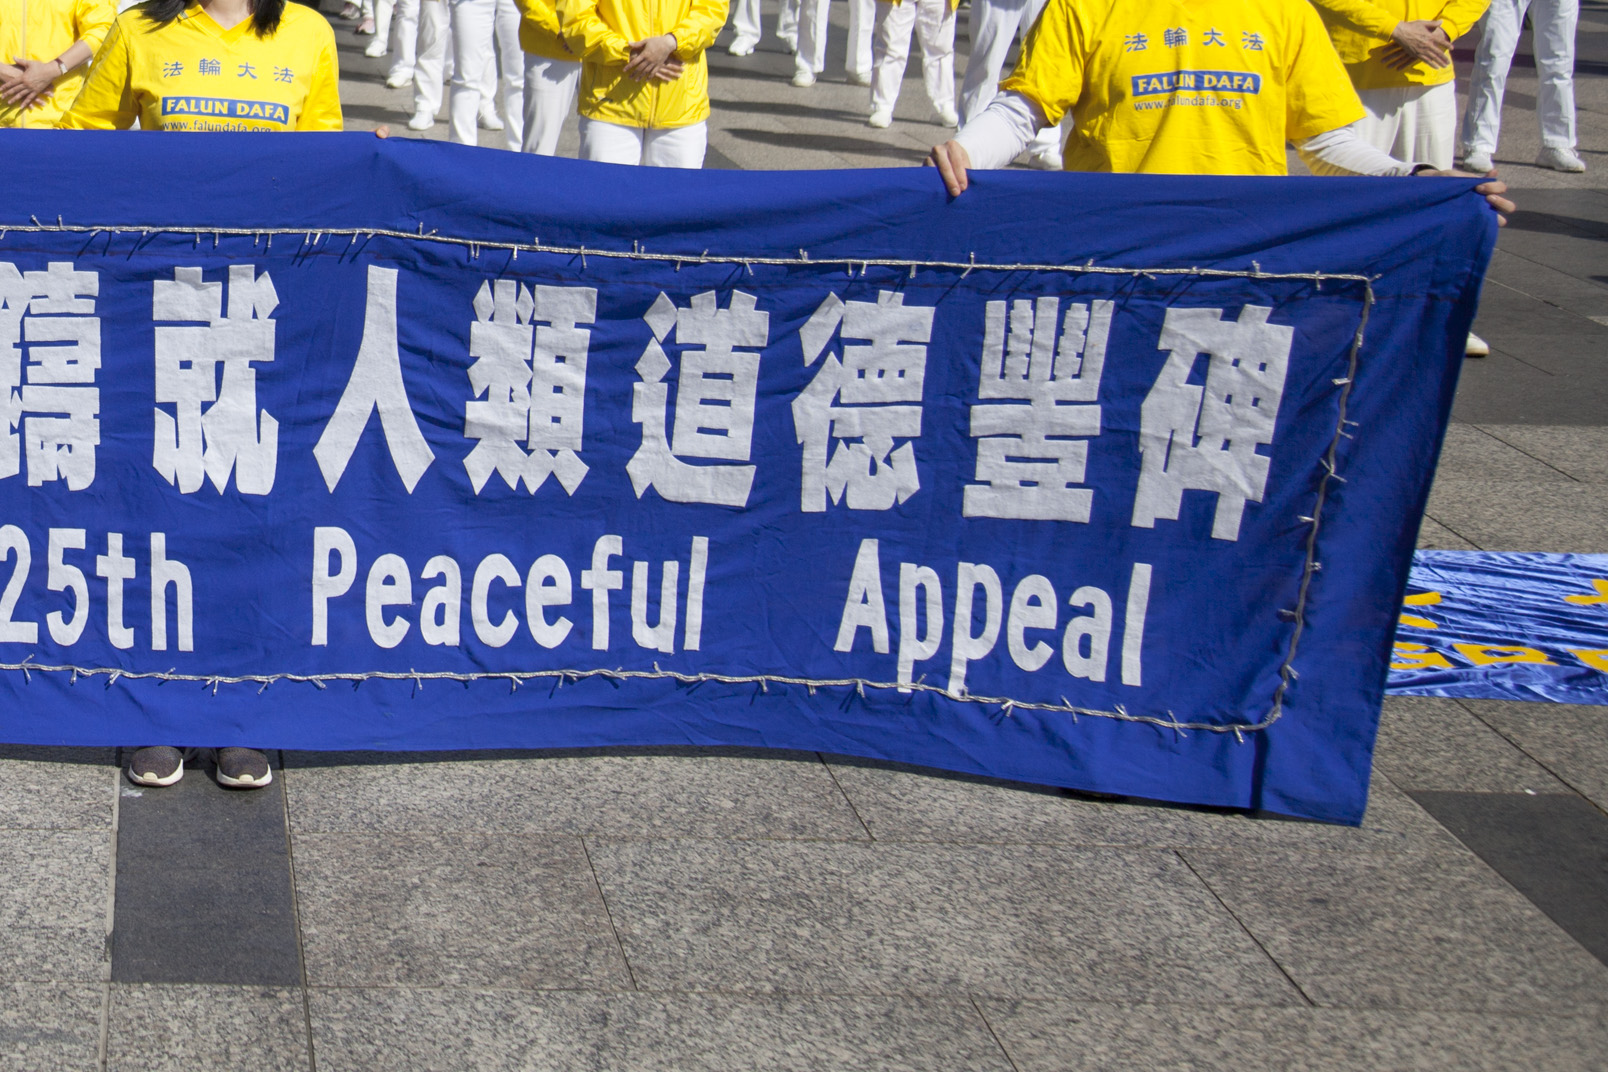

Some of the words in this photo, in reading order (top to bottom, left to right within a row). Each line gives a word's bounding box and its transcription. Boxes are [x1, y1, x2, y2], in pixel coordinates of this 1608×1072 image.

[1124, 26, 1264, 53] 法輪大法
[163, 58, 294, 84] 法輪大法
[1138, 74, 1195, 92] FALUN
[1203, 74, 1255, 91] DAFA
[166, 99, 228, 115] FALUN
[236, 102, 286, 121] DAFA
[310, 526, 709, 654] Peaceful
[833, 539, 1152, 698] Appeal
